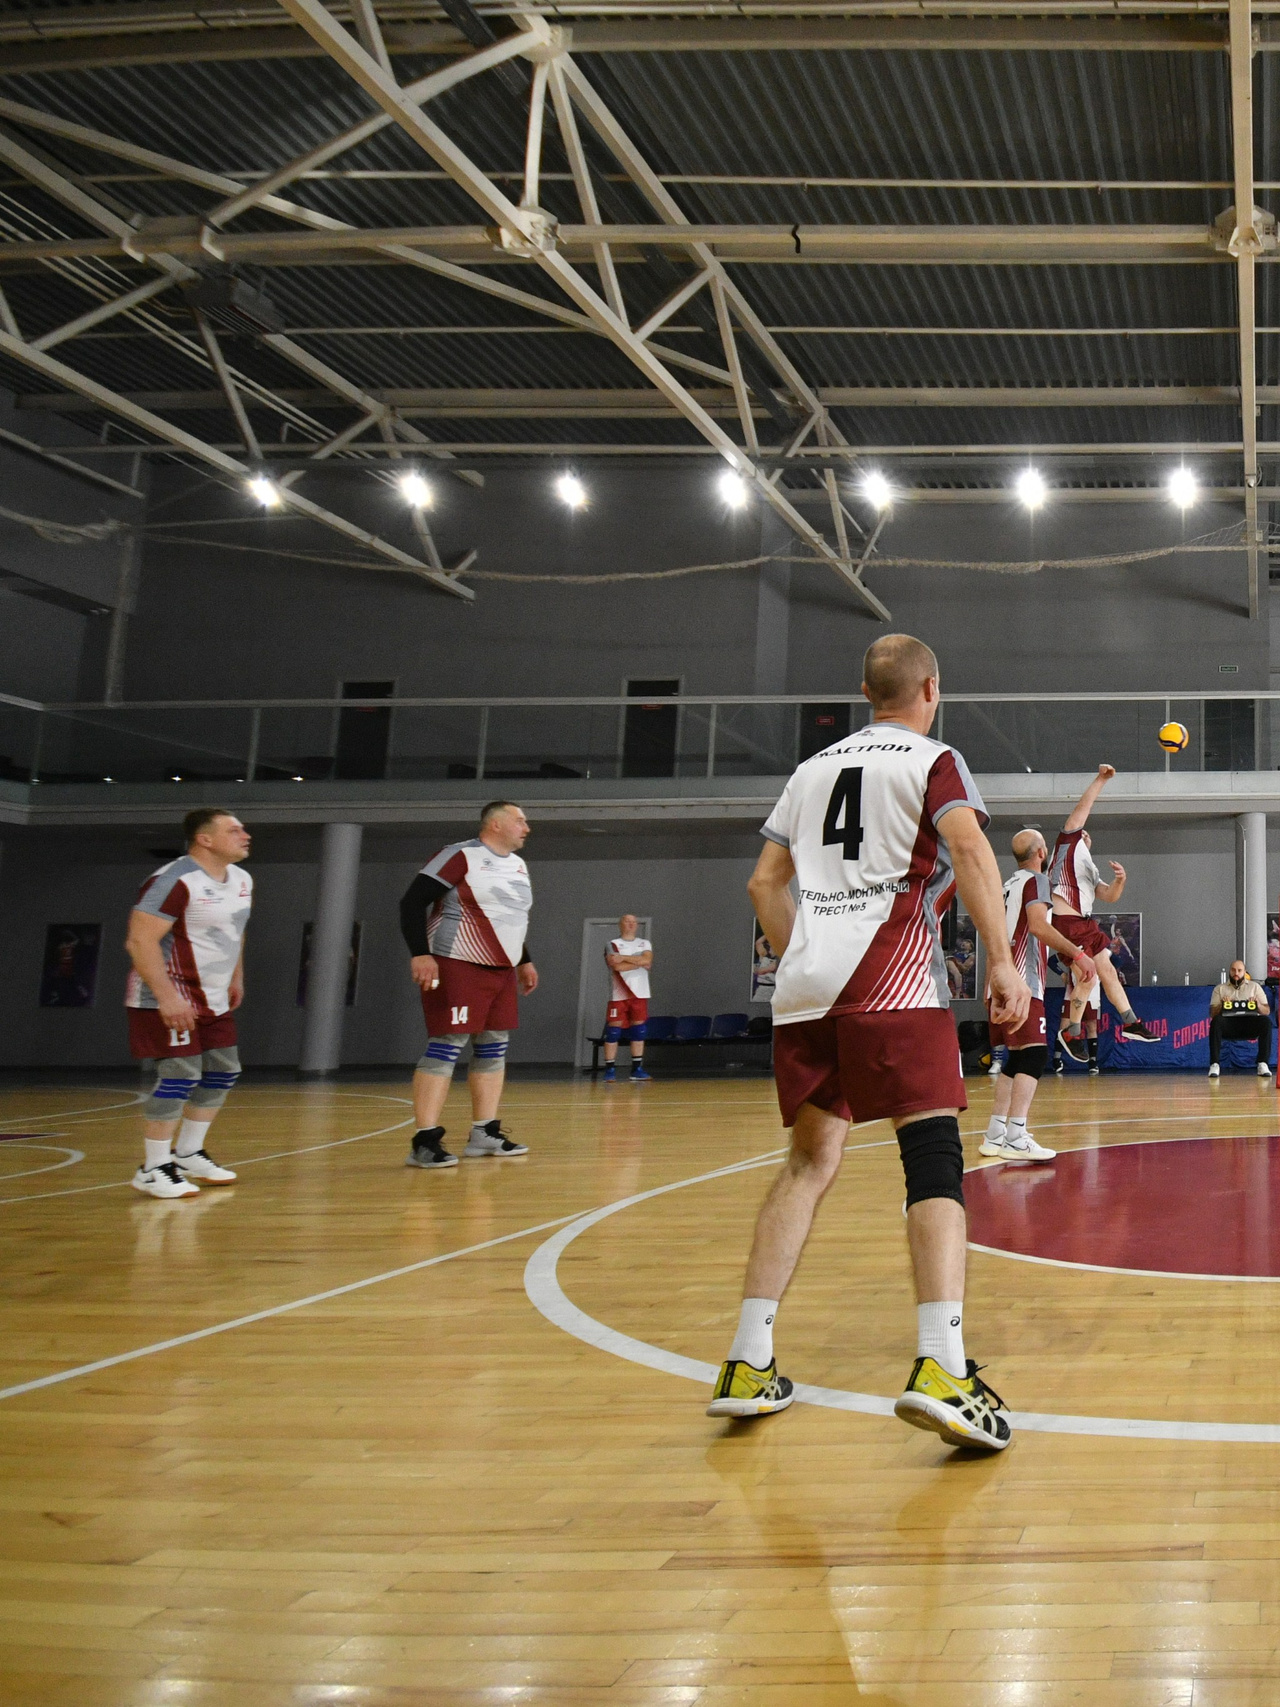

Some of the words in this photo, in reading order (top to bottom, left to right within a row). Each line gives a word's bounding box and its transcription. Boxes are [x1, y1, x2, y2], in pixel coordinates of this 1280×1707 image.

[821, 766, 864, 861] 4
[799, 881, 910, 905] ТЕЛЬНО-МОНТАЖНЫЙ
[813, 904, 847, 916] ТРЕСТ
[848, 902, 867, 913] №5
[450, 1005, 468, 1025] 14
